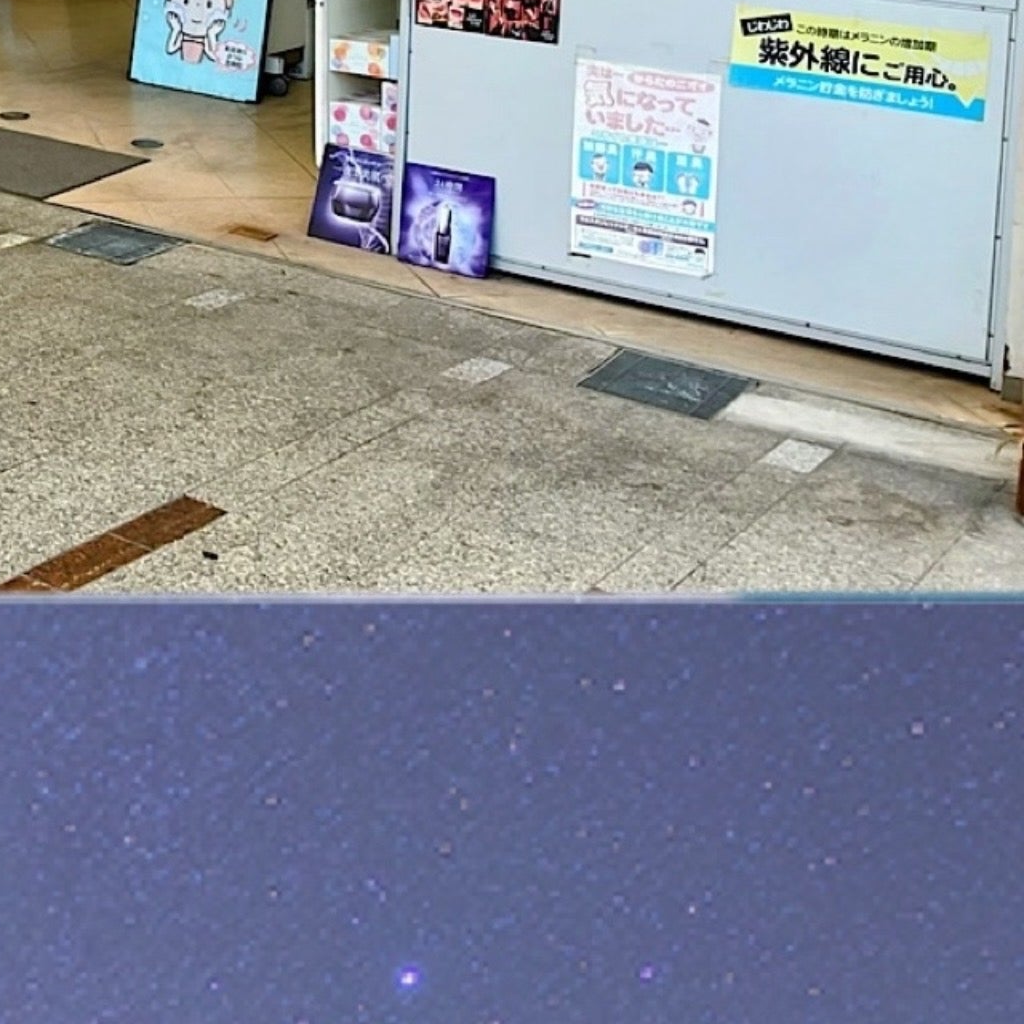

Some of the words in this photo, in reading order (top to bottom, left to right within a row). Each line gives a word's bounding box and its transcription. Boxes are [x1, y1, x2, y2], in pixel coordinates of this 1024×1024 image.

[758, 37, 957, 91] 紫外線にご用心。
